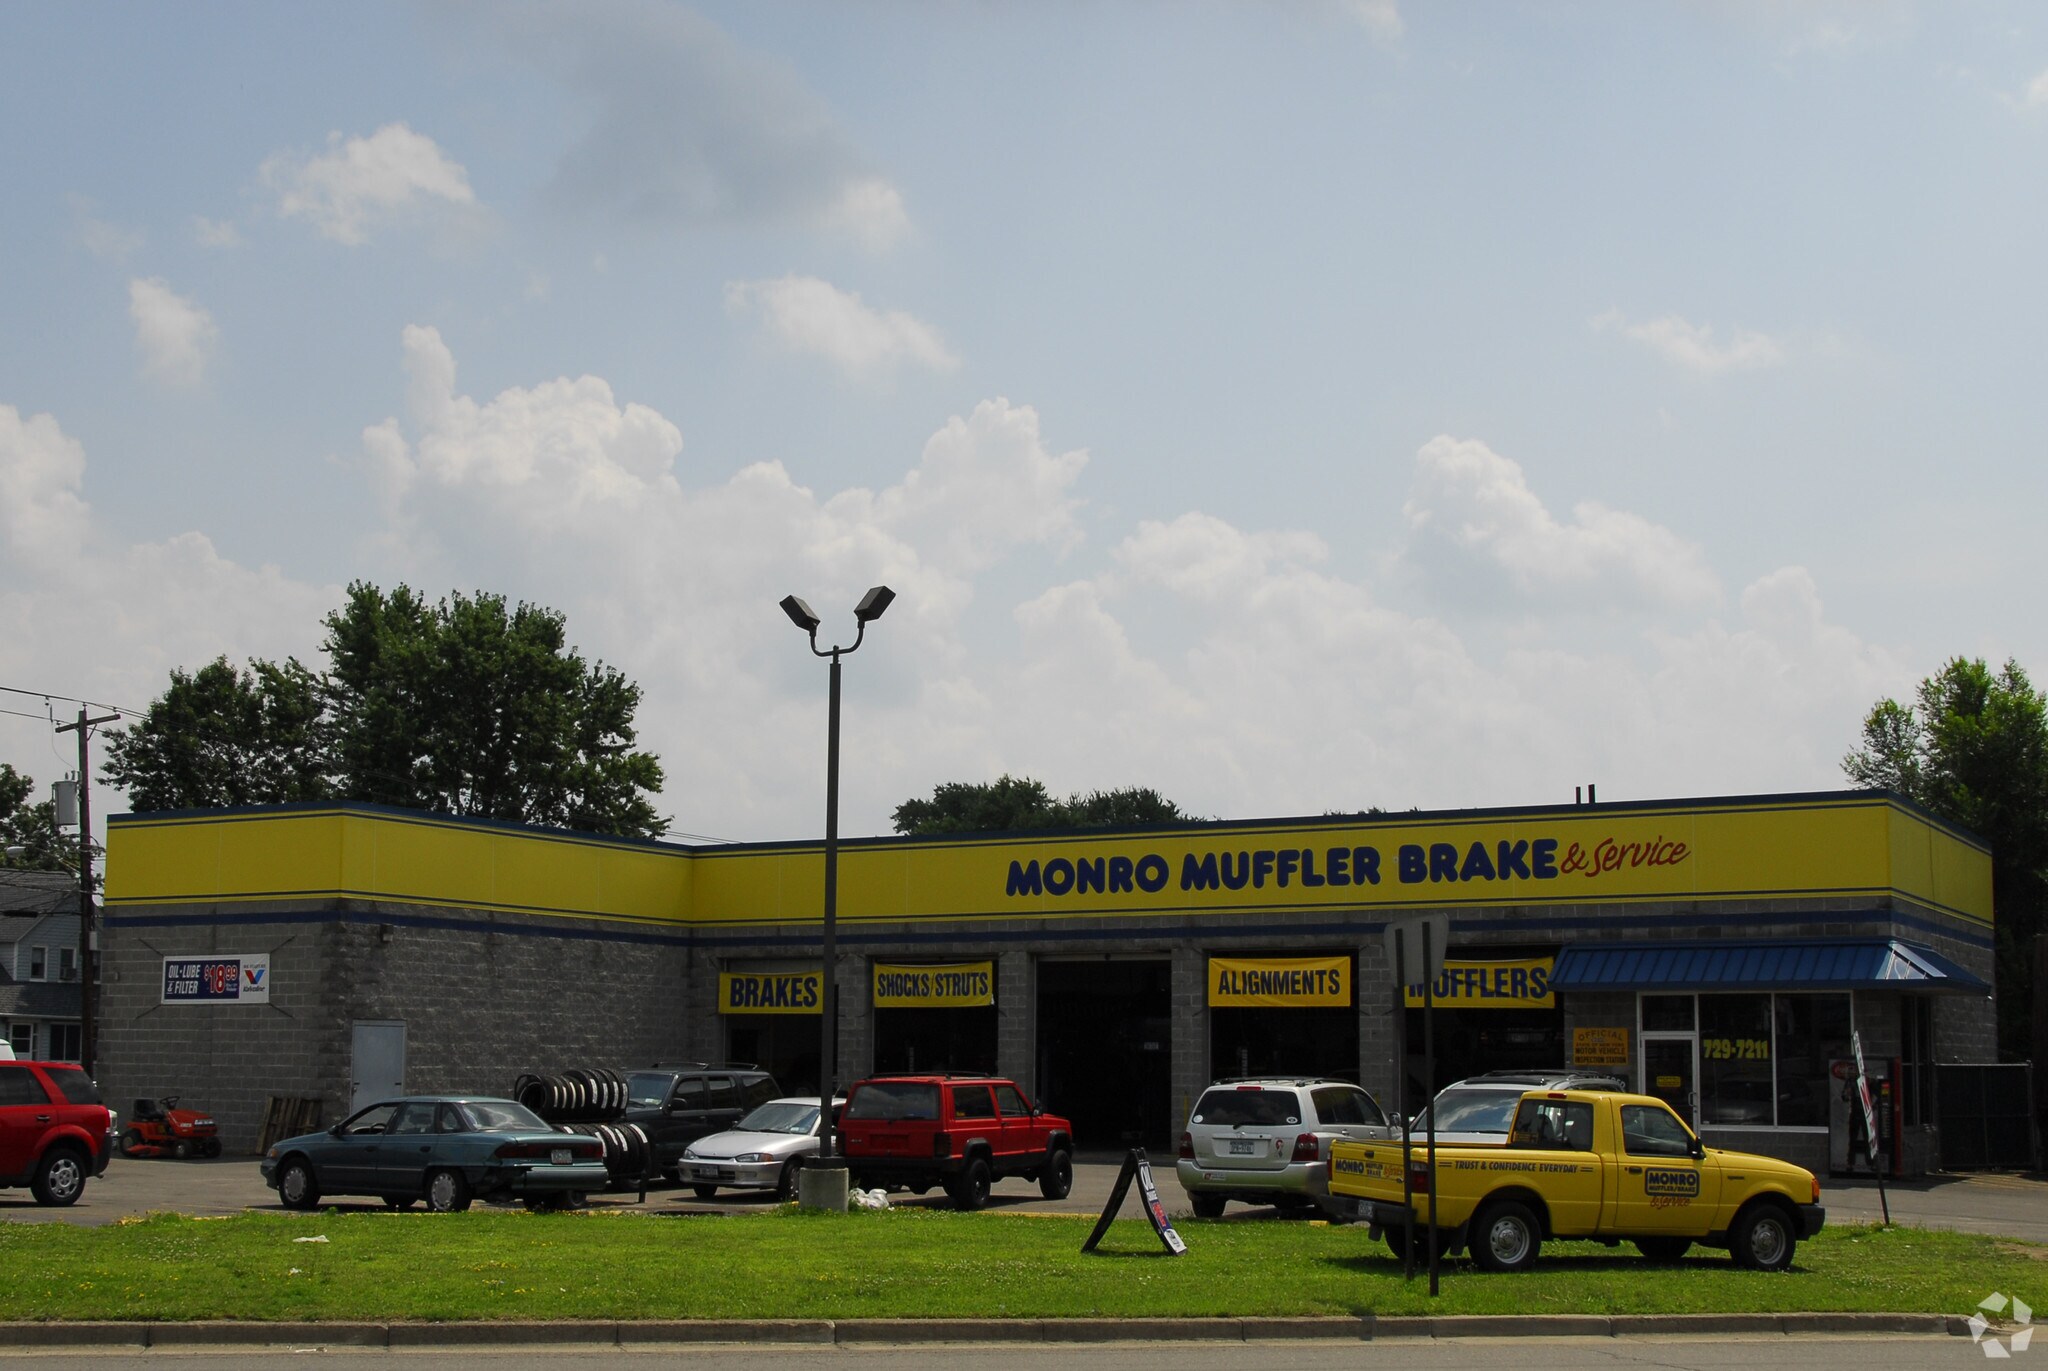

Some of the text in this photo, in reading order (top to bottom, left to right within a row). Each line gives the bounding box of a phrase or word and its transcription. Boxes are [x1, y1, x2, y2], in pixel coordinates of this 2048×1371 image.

[1005, 853, 1170, 897] MONRO
[1179, 846, 1381, 892] MUFFLER
[1398, 838, 1558, 885] BRAKE
[174, 980, 199, 994] FILTER
[877, 971, 989, 999] SHOCKS/STRUTS
[1217, 968, 1342, 996] ALIGNMENTS
[730, 976, 819, 1009] BRAKES
[1578, 1029, 1624, 1042] OFFICIAL
[1575, 1047, 1626, 1055] MOTOR VEHICLE
[1703, 1039, 1769, 1060] 729-7211
[1606, 1056, 1627, 1064] STATION
[1335, 1159, 1365, 1174] MONRO
[1454, 1160, 1579, 1174] TRUST & CONFIDENCE EVERYDAY
[1649, 1173, 1696, 1186] MONRO
